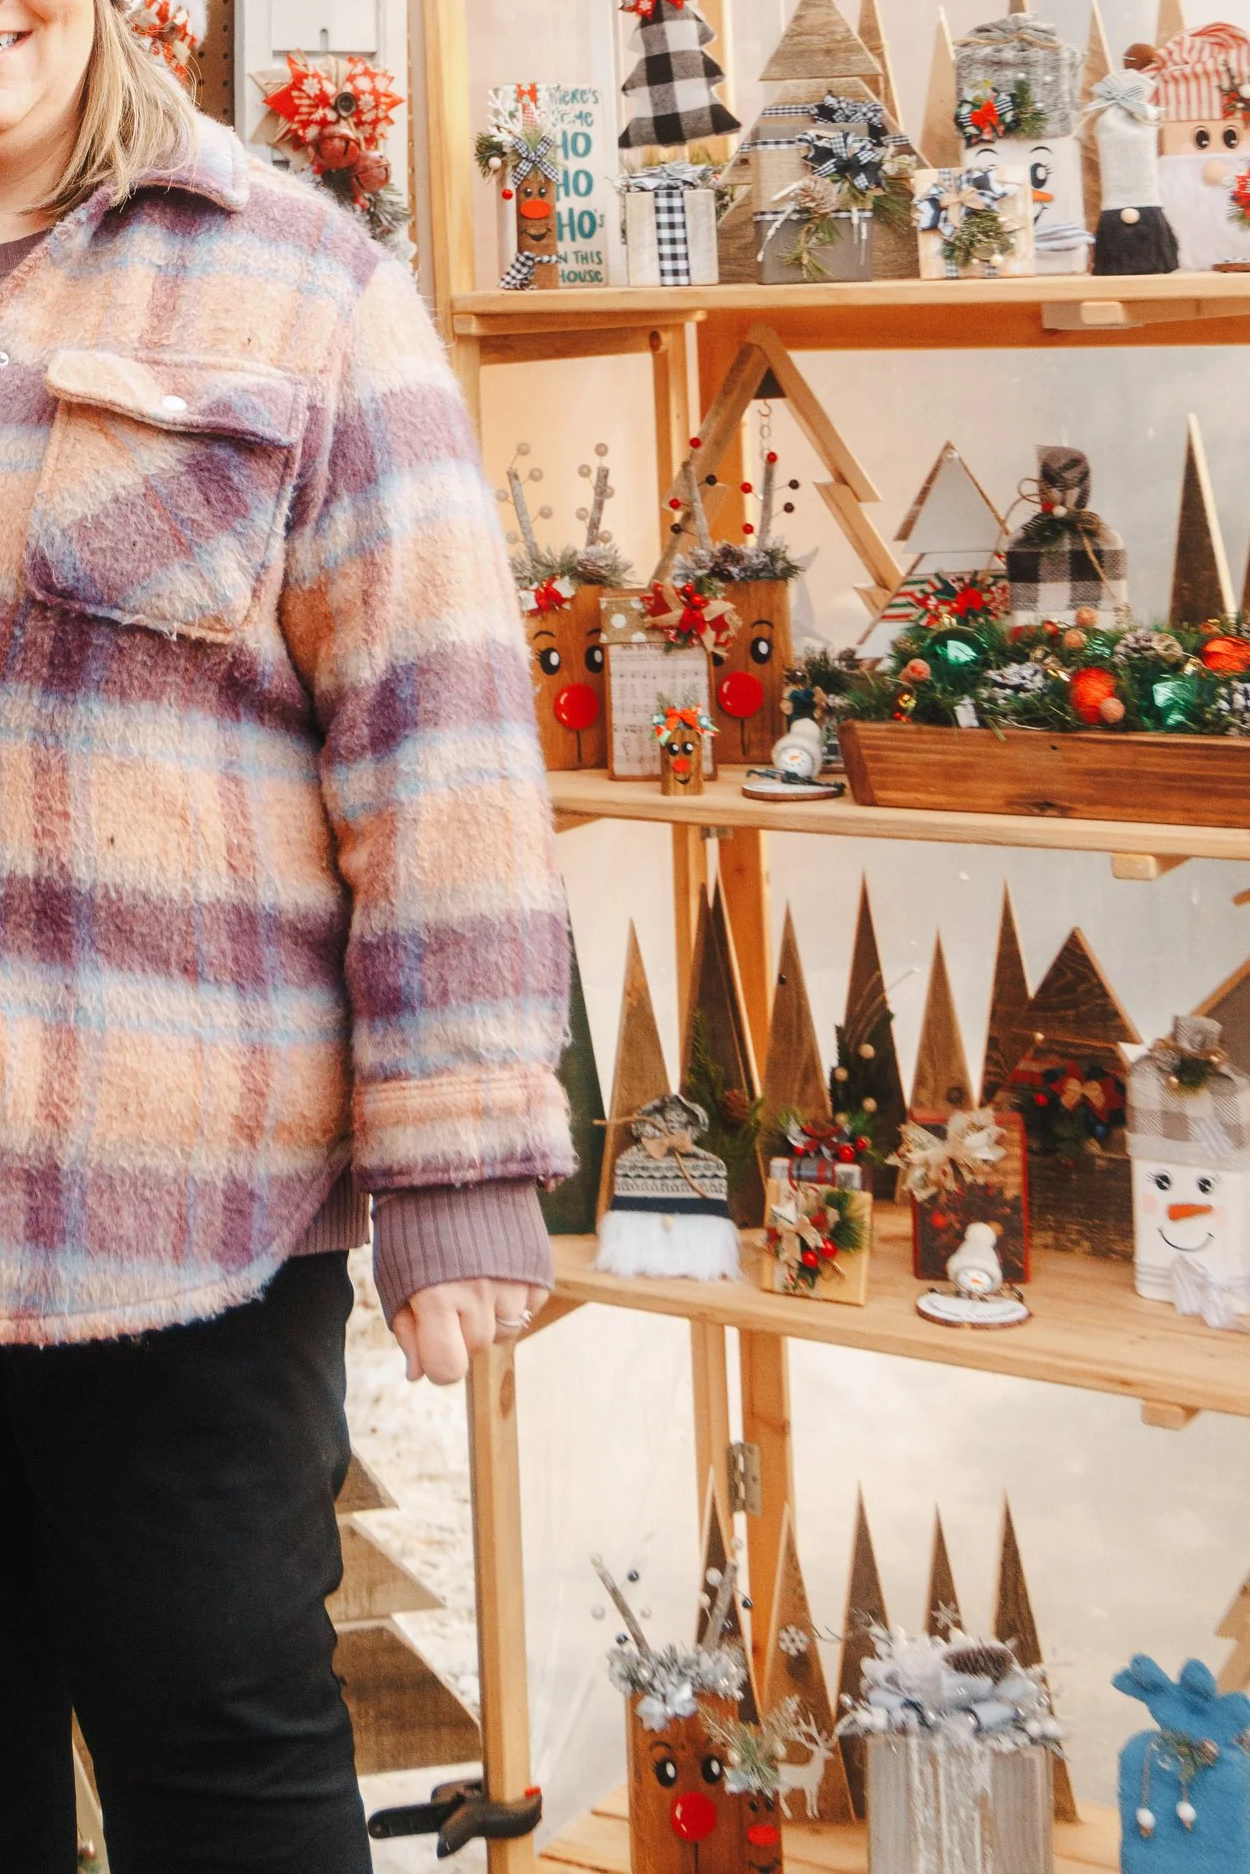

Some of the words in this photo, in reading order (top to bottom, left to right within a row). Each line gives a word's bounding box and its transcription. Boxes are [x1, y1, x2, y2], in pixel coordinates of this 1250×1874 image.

[554, 129, 592, 161] HO
[555, 168, 594, 203] HO
[572, 249, 603, 266] THIS
